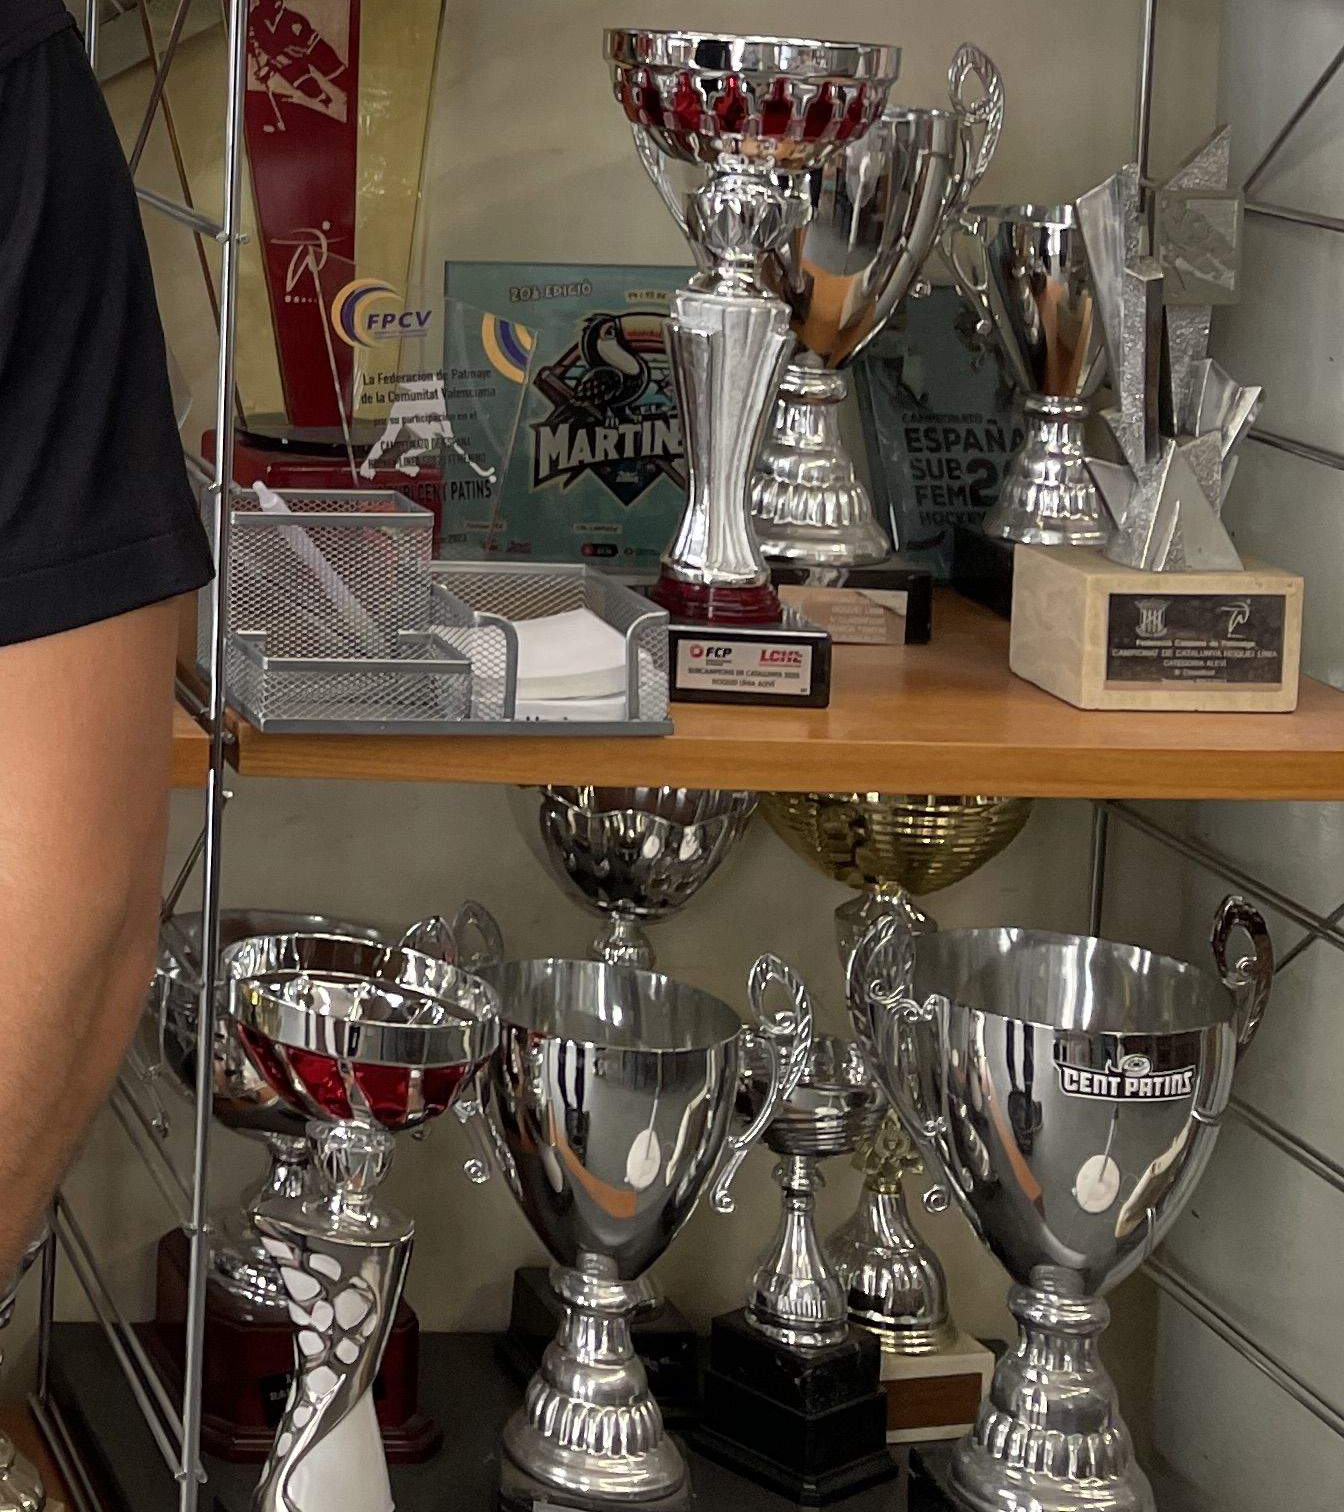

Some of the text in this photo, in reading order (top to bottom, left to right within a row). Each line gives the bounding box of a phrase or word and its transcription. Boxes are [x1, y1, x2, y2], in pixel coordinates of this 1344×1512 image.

[366, 310, 432, 330] FPCV
[363, 374, 375, 386] La
[436, 369, 447, 380] de
[361, 392, 373, 404] de
[375, 391, 386, 403] la
[904, 418, 1026, 454] ESPAÑA
[910, 458, 962, 481] SUB
[450, 481, 493, 501] PATINS
[705, 647, 732, 659] FCP
[1062, 1067, 1193, 1097] CENT PATINS
